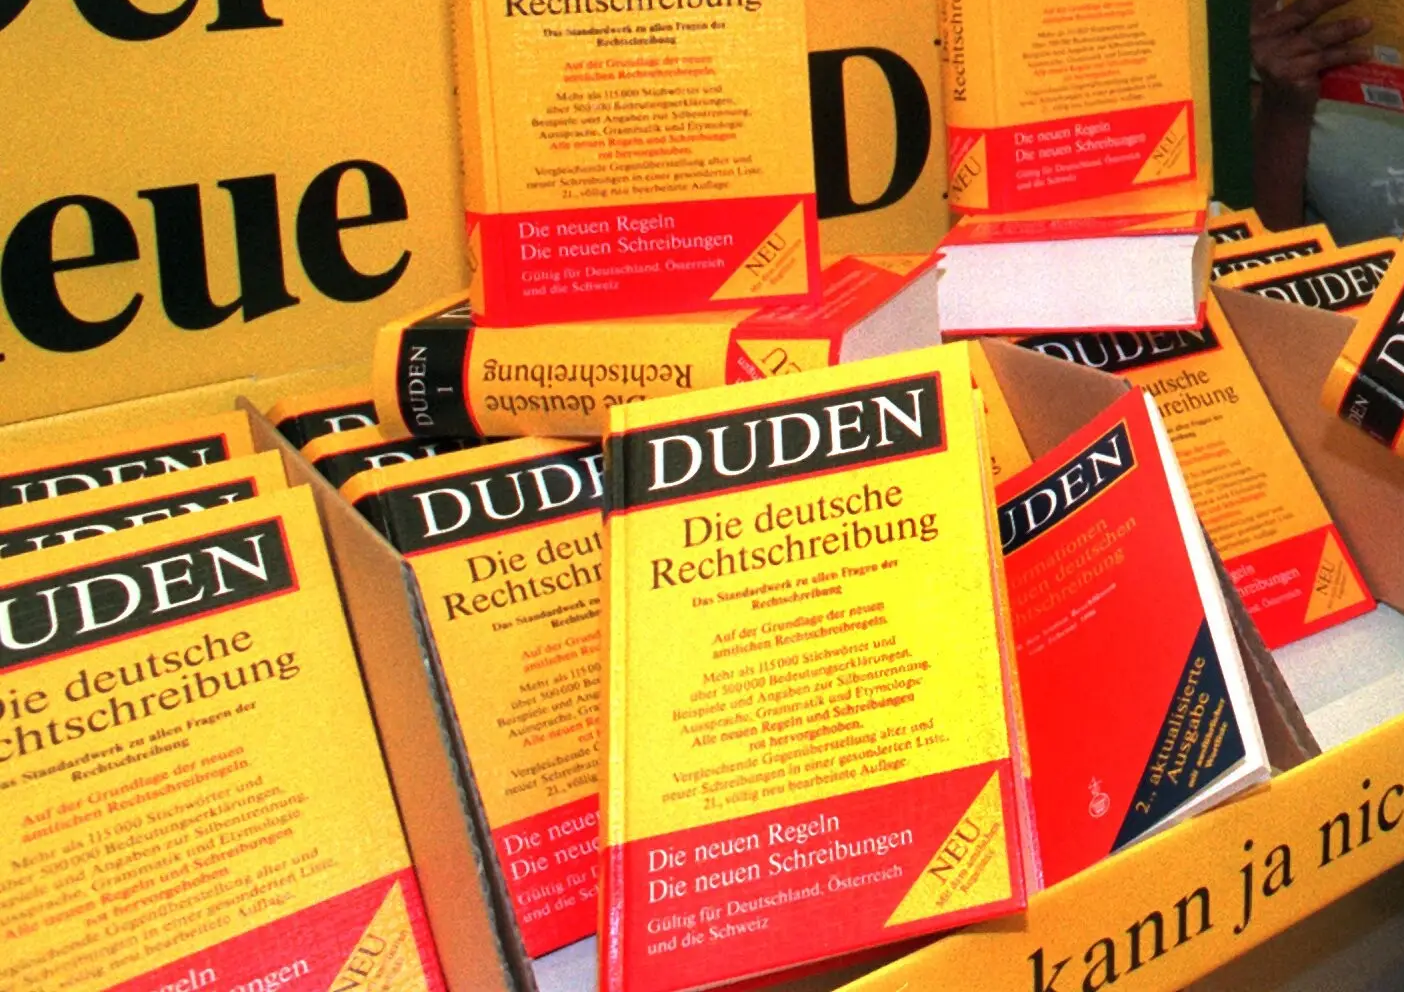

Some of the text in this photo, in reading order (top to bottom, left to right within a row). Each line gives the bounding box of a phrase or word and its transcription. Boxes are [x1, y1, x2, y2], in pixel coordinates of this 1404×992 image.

[1014, 120, 1111, 146] Die neuen Regeln
[1015, 131, 1148, 163] Die neuen Schreibungen
[518, 214, 676, 241] Die neuen Regeln
[521, 232, 734, 261] Die neuen Schreibungen
[744, 232, 788, 278] NEU
[544, 279, 620, 296] die Schweiz
[411, 343, 430, 428] DUDEN
[483, 359, 693, 389] Rechtschreibung
[484, 394, 596, 415] deutsche
[647, 388, 924, 493] DUDEN
[684, 483, 903, 548] Die deutsche
[467, 550, 527, 584] Die
[650, 513, 939, 590] Rechtschreibung
[1055, 516, 1136, 582] deutschen
[0, 532, 270, 650] UDEN
[717, 579, 792, 603] Standardwerk
[1315, 560, 1336, 596] NEU
[712, 602, 884, 645] Auf Grundlage neuen
[65, 630, 254, 702] deutsche
[712, 639, 772, 659] amtlichen
[1150, 657, 1206, 785] aktualisierte
[1168, 692, 1210, 785] Ausgabe
[504, 832, 542, 856] Die
[647, 815, 840, 873] Die neuen Regeln
[647, 827, 913, 904] Die neuen Schreibungen
[926, 816, 982, 884] NEU
[510, 856, 549, 881] Die
[647, 863, 904, 935] Gültig für Österreich
[1027, 879, 1213, 992] kann
[1232, 838, 1295, 935] ja
[647, 916, 770, 955] und die Schweiz
